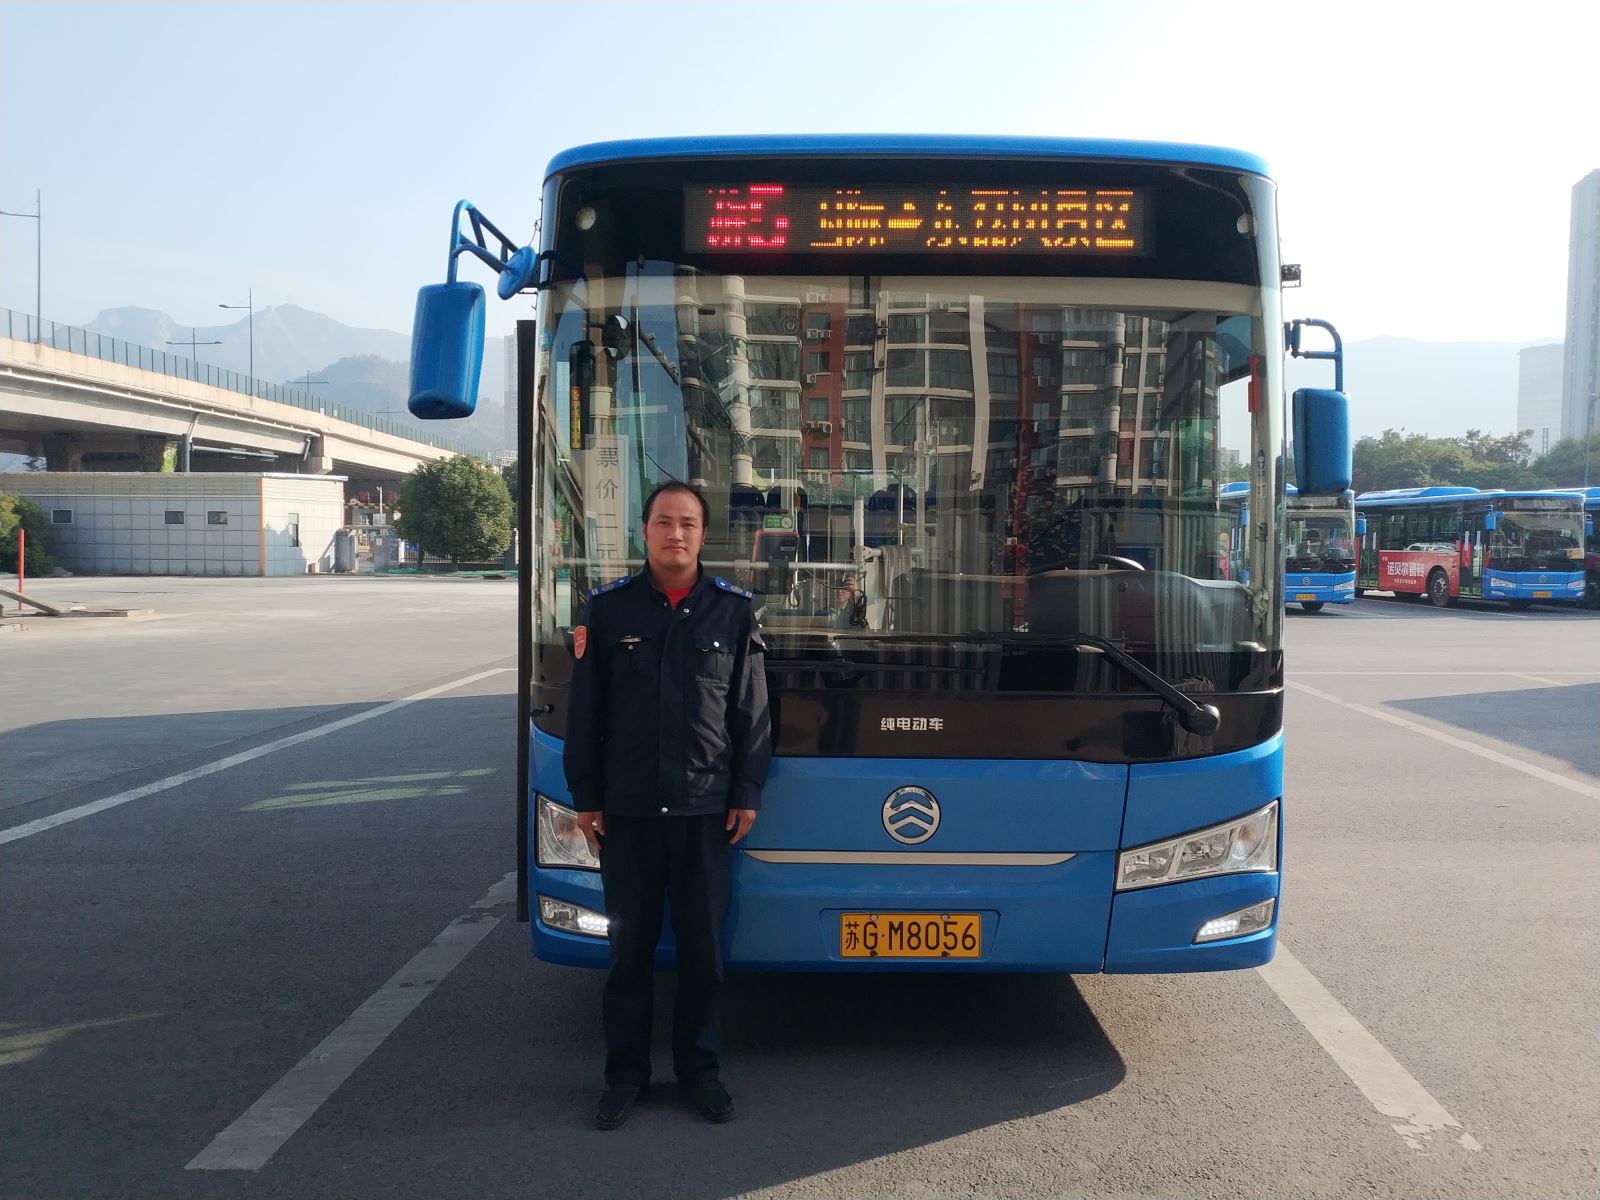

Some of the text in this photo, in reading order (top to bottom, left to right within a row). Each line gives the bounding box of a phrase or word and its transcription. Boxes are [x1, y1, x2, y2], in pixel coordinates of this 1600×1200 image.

[595, 447, 619, 562] 票价二元
[880, 717, 944, 731] 纯电动车
